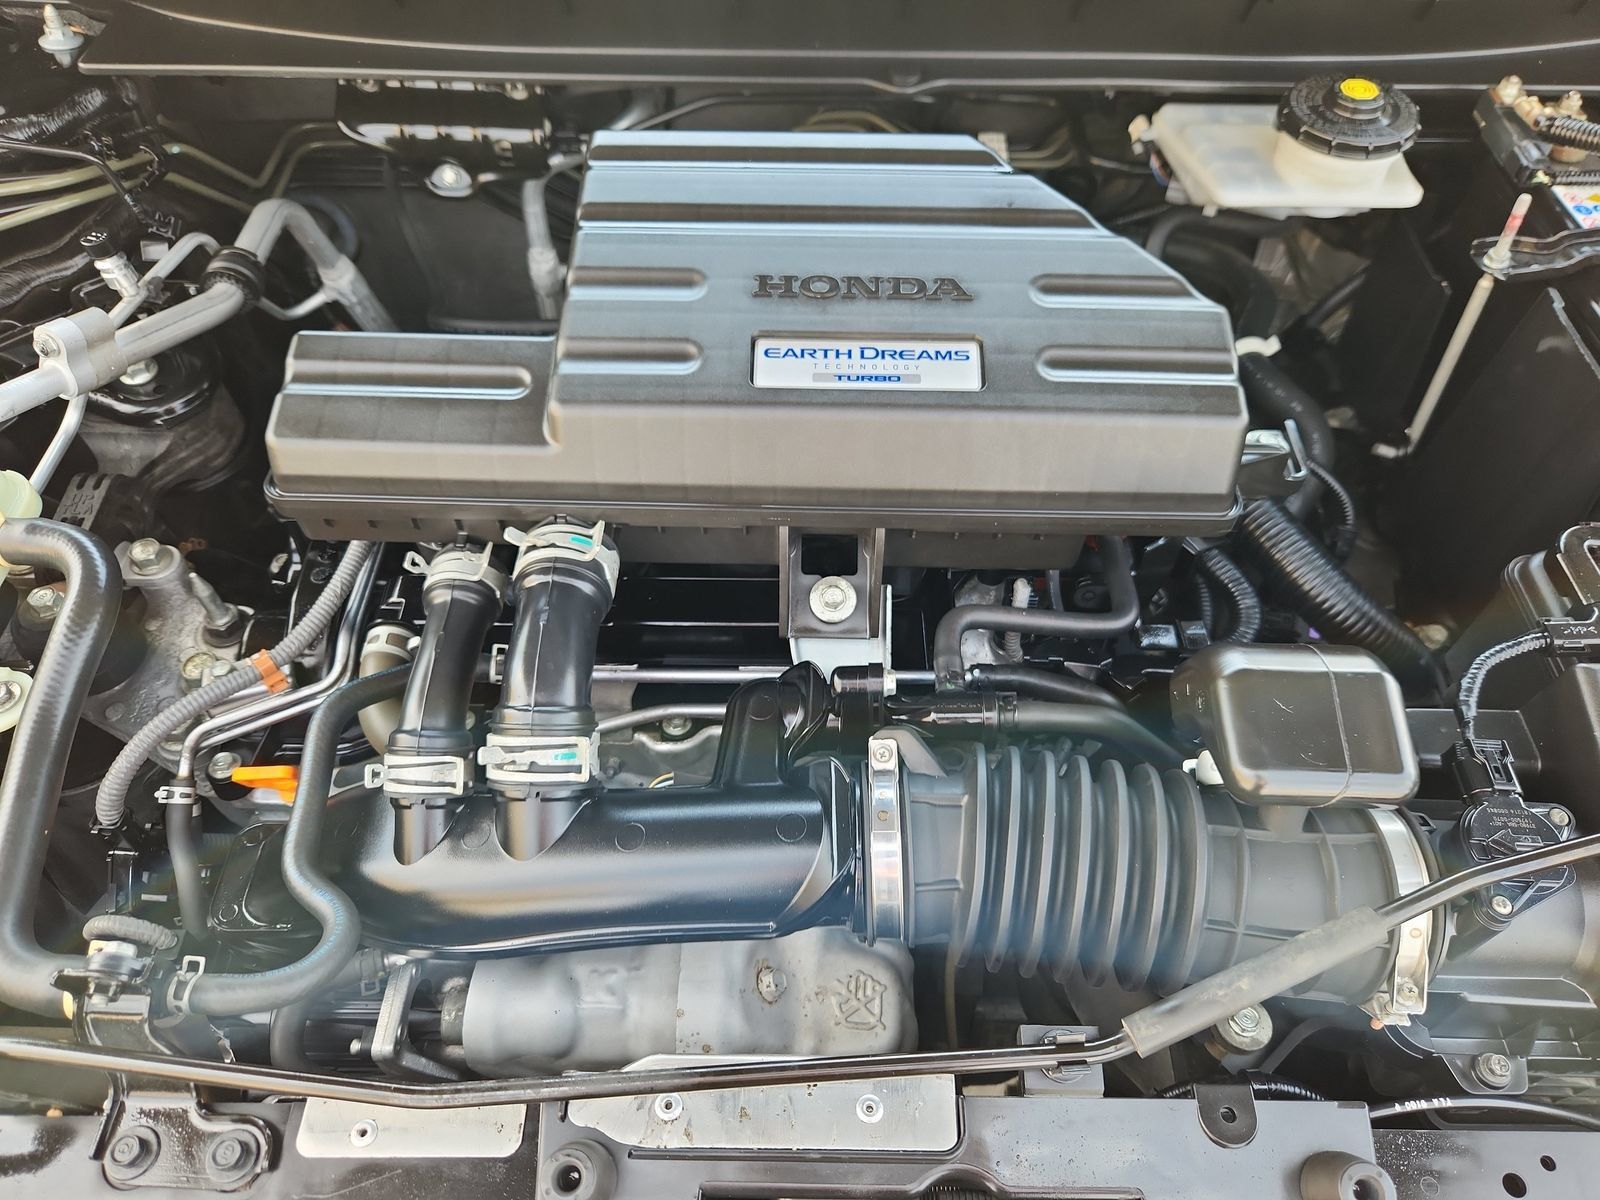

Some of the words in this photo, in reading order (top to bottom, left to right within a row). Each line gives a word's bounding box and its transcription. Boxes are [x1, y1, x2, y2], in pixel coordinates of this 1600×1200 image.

[752, 274, 975, 300] HONDA
[763, 347, 852, 359] EARTH
[859, 347, 970, 361] DREAMS
[813, 363, 920, 371] TECHNOLOGY
[834, 374, 901, 382] TURBO
